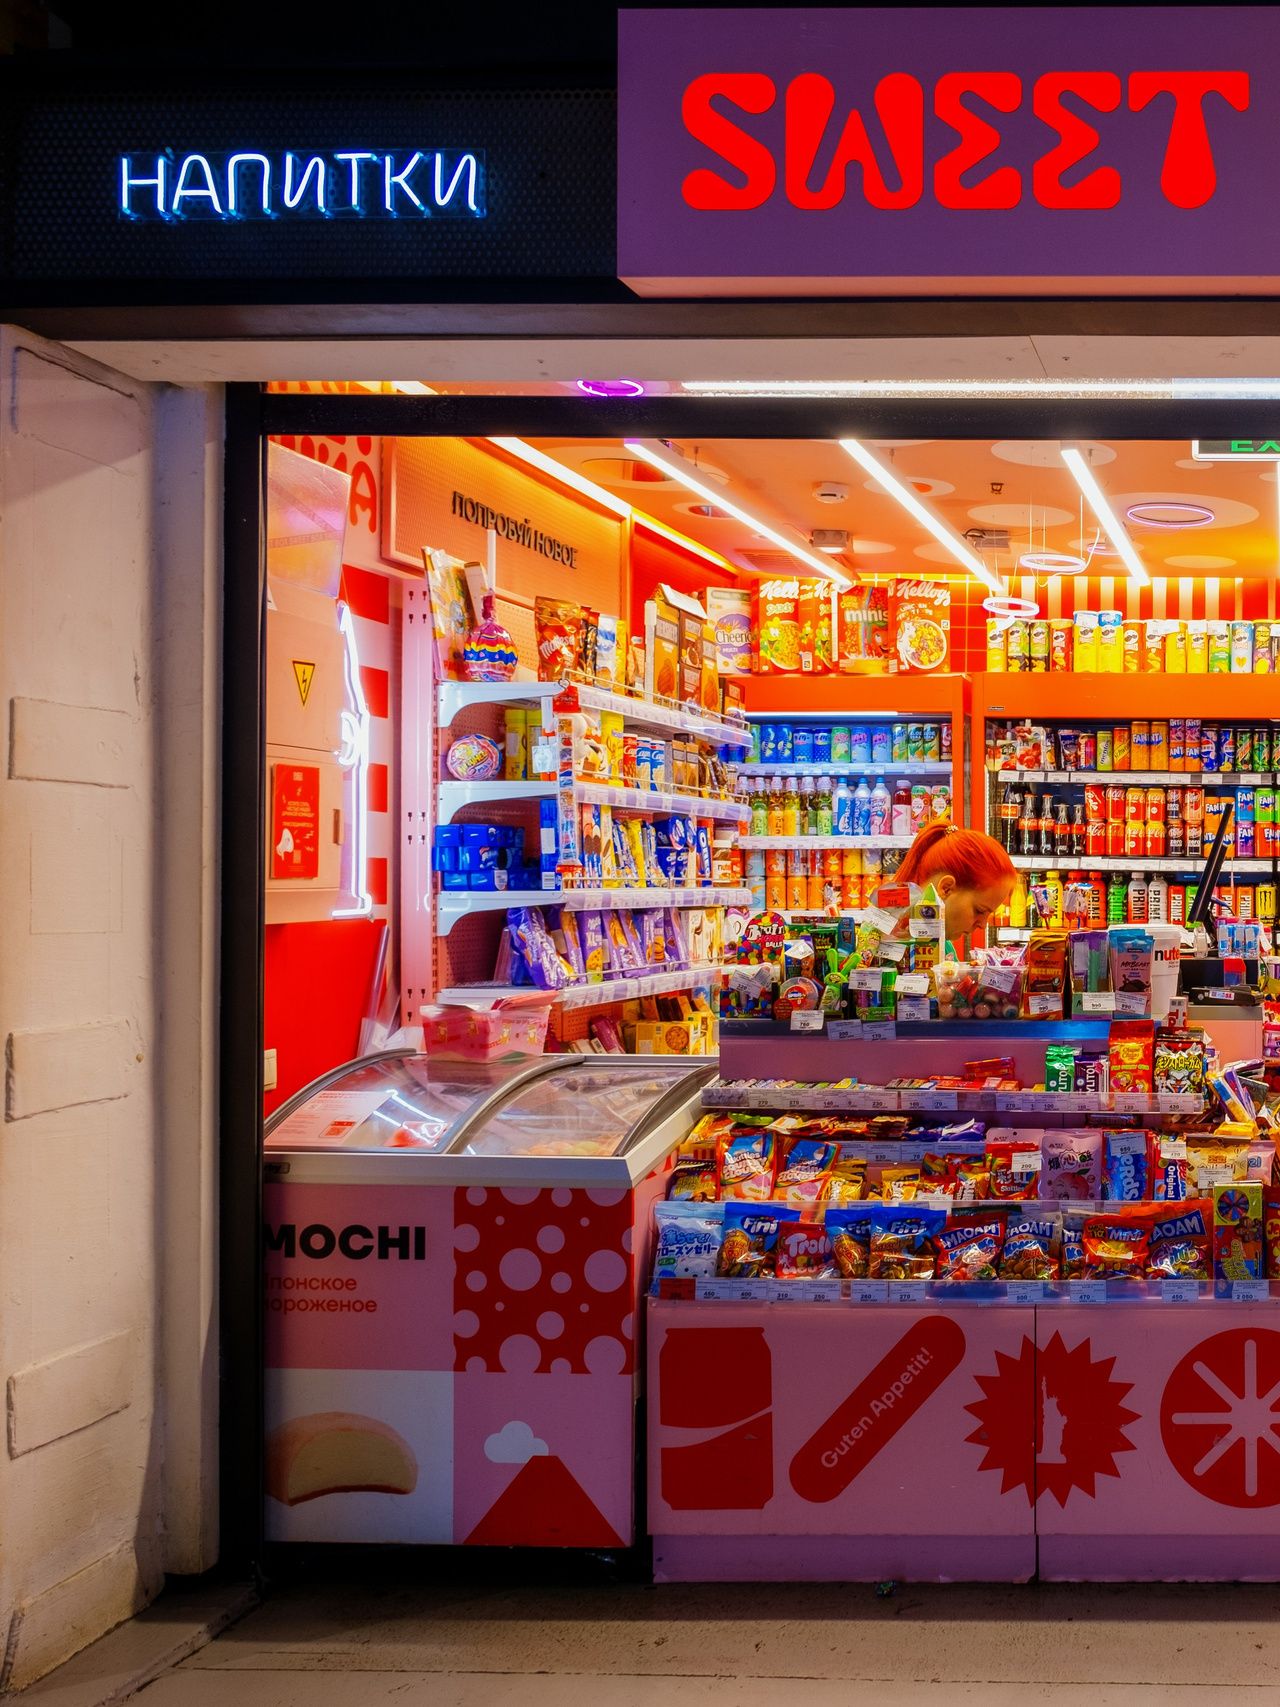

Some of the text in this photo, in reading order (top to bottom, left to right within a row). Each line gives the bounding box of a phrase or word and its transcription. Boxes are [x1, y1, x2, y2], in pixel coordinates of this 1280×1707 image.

[682, 71, 1249, 210] SWEET
[121, 152, 482, 215] НАПИТКИ
[452, 490, 578, 569] ПОПРОБУЙ НОВОЕ
[759, 580, 799, 600] Kell
[896, 581, 951, 607] Kellogg
[1100, 738, 1111, 765] mentos
[1132, 732, 1150, 744] FANT
[1132, 888, 1146, 920] PRIME
[1151, 889, 1161, 920] PRIME
[1171, 893, 1182, 921] PRIME
[746, 923, 787, 941] Brain
[1057, 1067, 1068, 1093] YLITO
[1085, 1062, 1096, 1094] YLITOL
[1000, 1185, 1026, 1193] Skittles
[742, 1216, 780, 1235] Fini
[846, 1222, 872, 1237] Fin
[889, 1220, 930, 1234] Fini
[942, 1222, 997, 1250] MAOAM
[263, 1223, 426, 1261] MOCHI
[785, 1233, 831, 1257] Troll
[821, 1346, 934, 1468] Guten Appetit!
